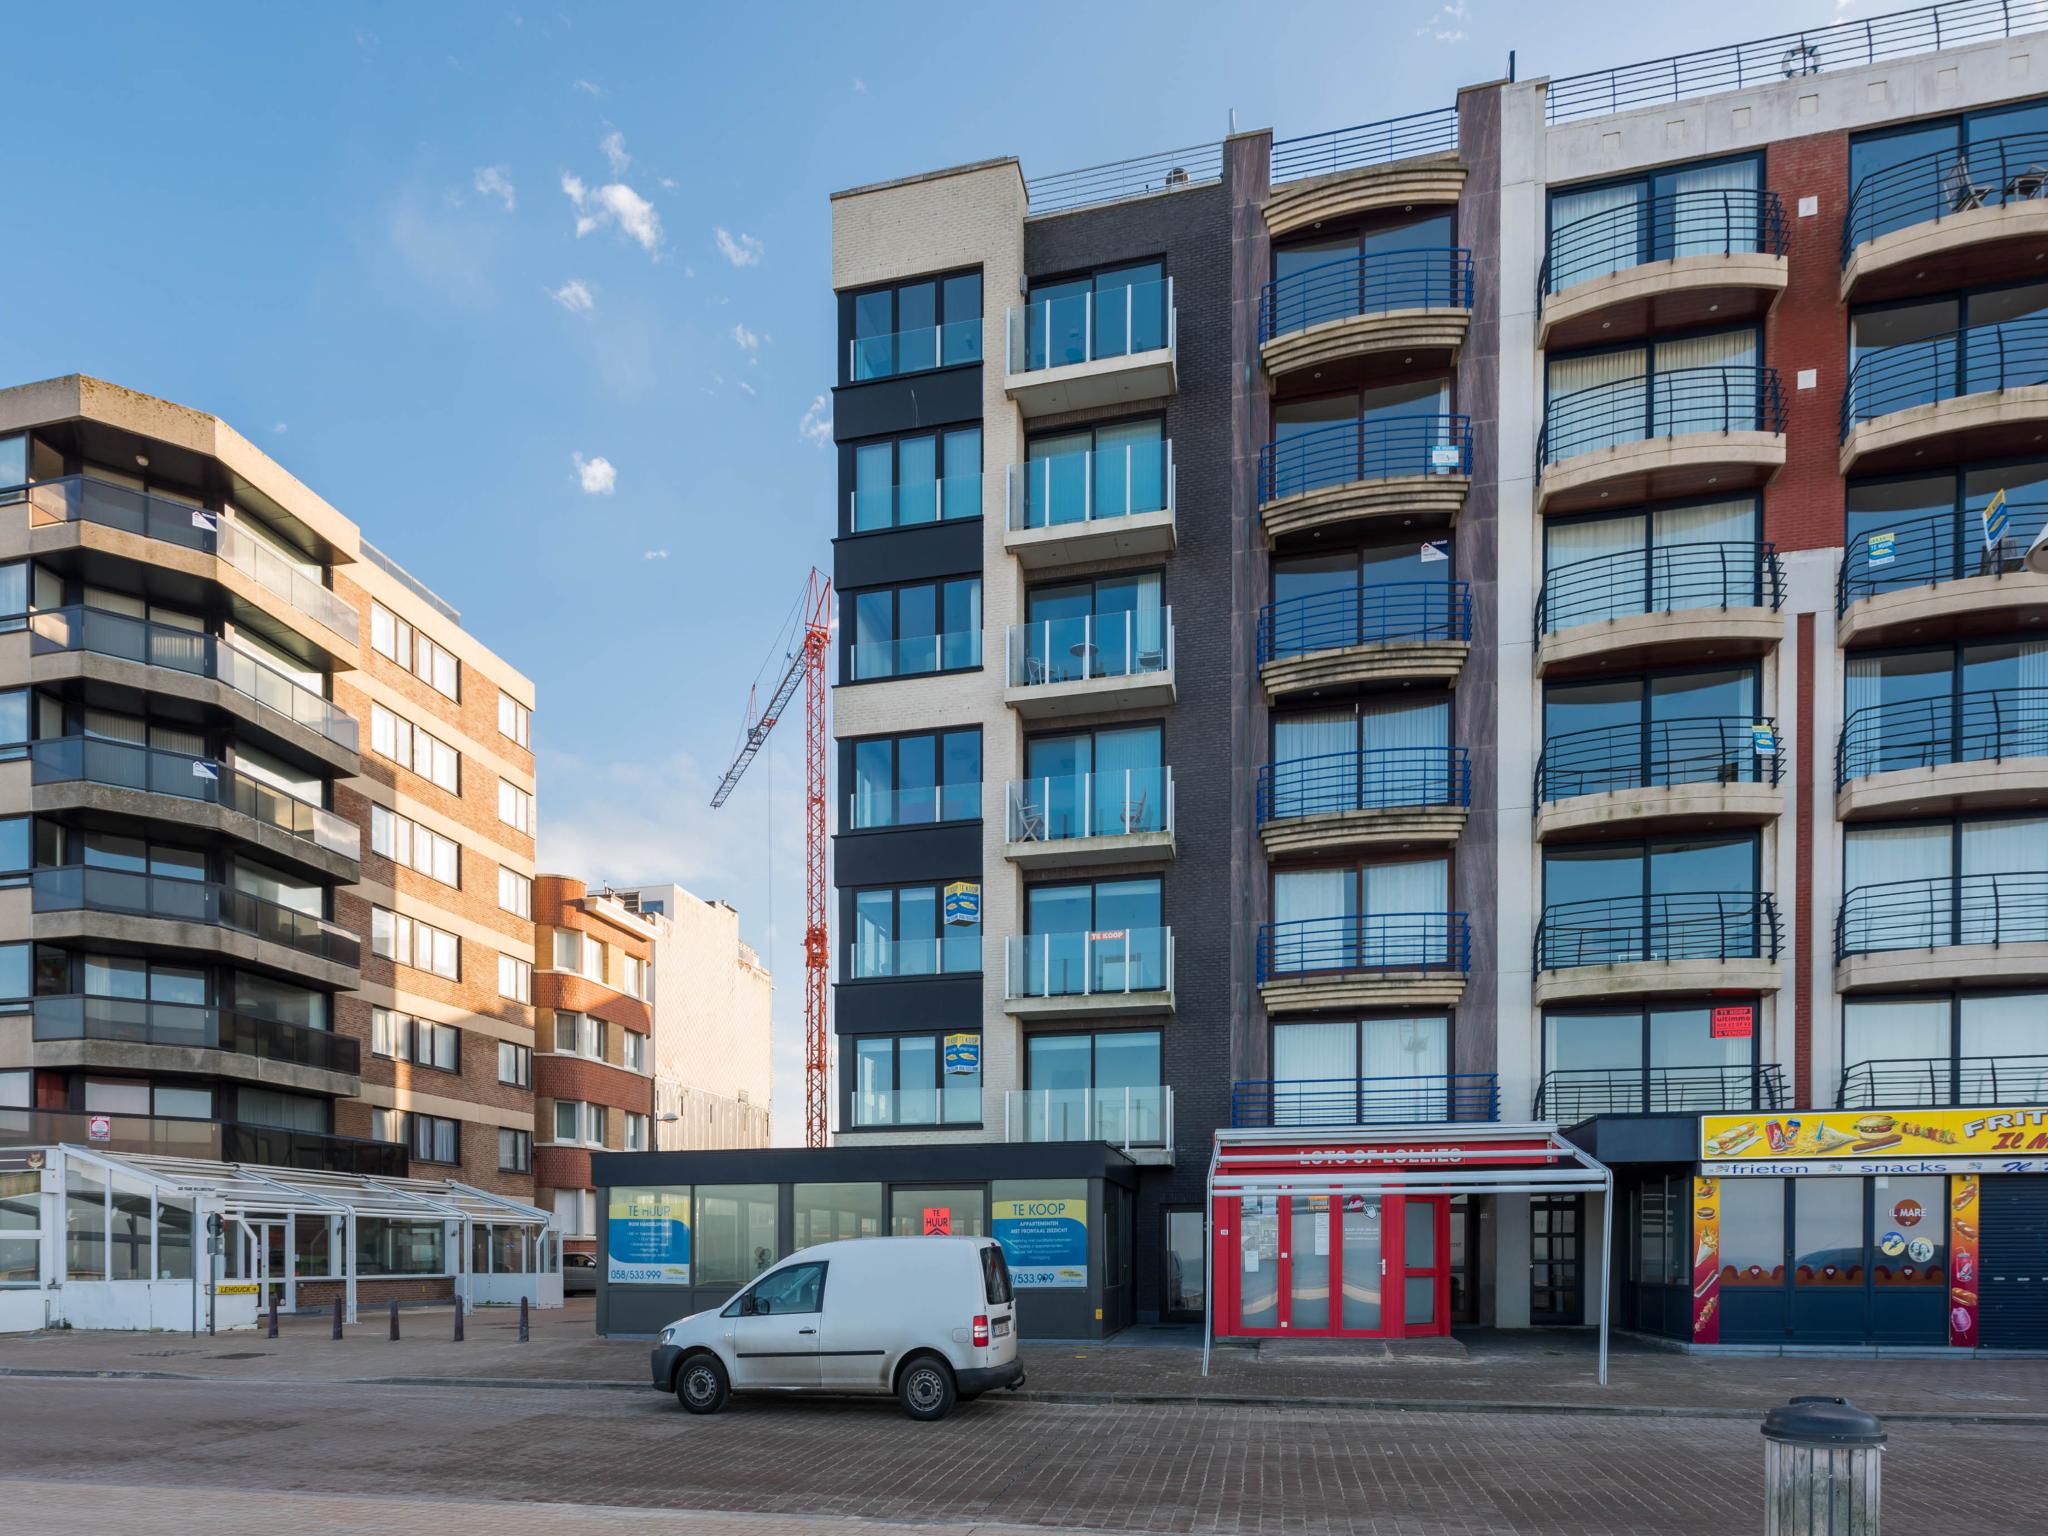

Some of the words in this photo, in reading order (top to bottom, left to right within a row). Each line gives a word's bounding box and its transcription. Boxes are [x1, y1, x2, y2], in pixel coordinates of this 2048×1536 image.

[1732, 1163, 1808, 1174] frieten
[1860, 1161, 1947, 1173] snacks
[628, 1205, 638, 1217] TE
[932, 1209, 941, 1217] TE
[1012, 1203, 1025, 1216] TE
[1029, 1203, 1066, 1216] KOOP
[1888, 1208, 1898, 1217] IL
[1900, 1208, 1927, 1217] MARE
[926, 1216, 948, 1227] HUUR
[610, 1270, 662, 1280] 058/533.999
